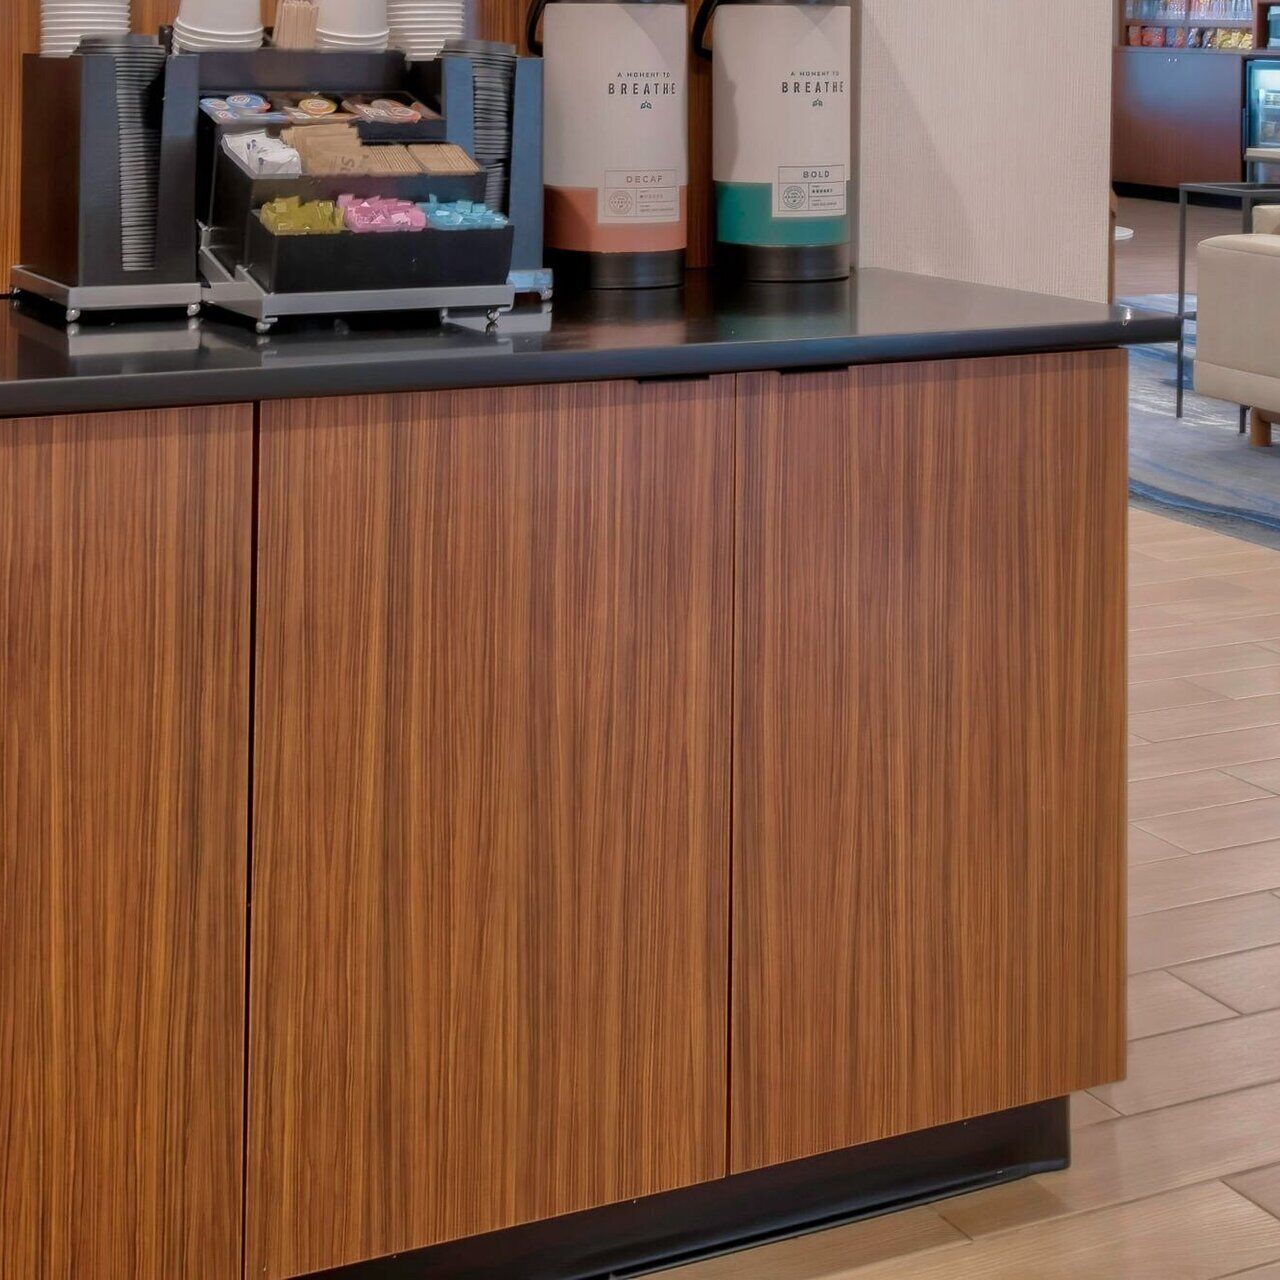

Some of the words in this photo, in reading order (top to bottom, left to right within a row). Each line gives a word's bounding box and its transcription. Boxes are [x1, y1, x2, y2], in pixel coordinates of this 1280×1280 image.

[608, 82, 676, 95] BREATHE
[781, 81, 844, 93] BREATHE
[626, 174, 663, 183] DECAF
[802, 170, 830, 179] BOLD
